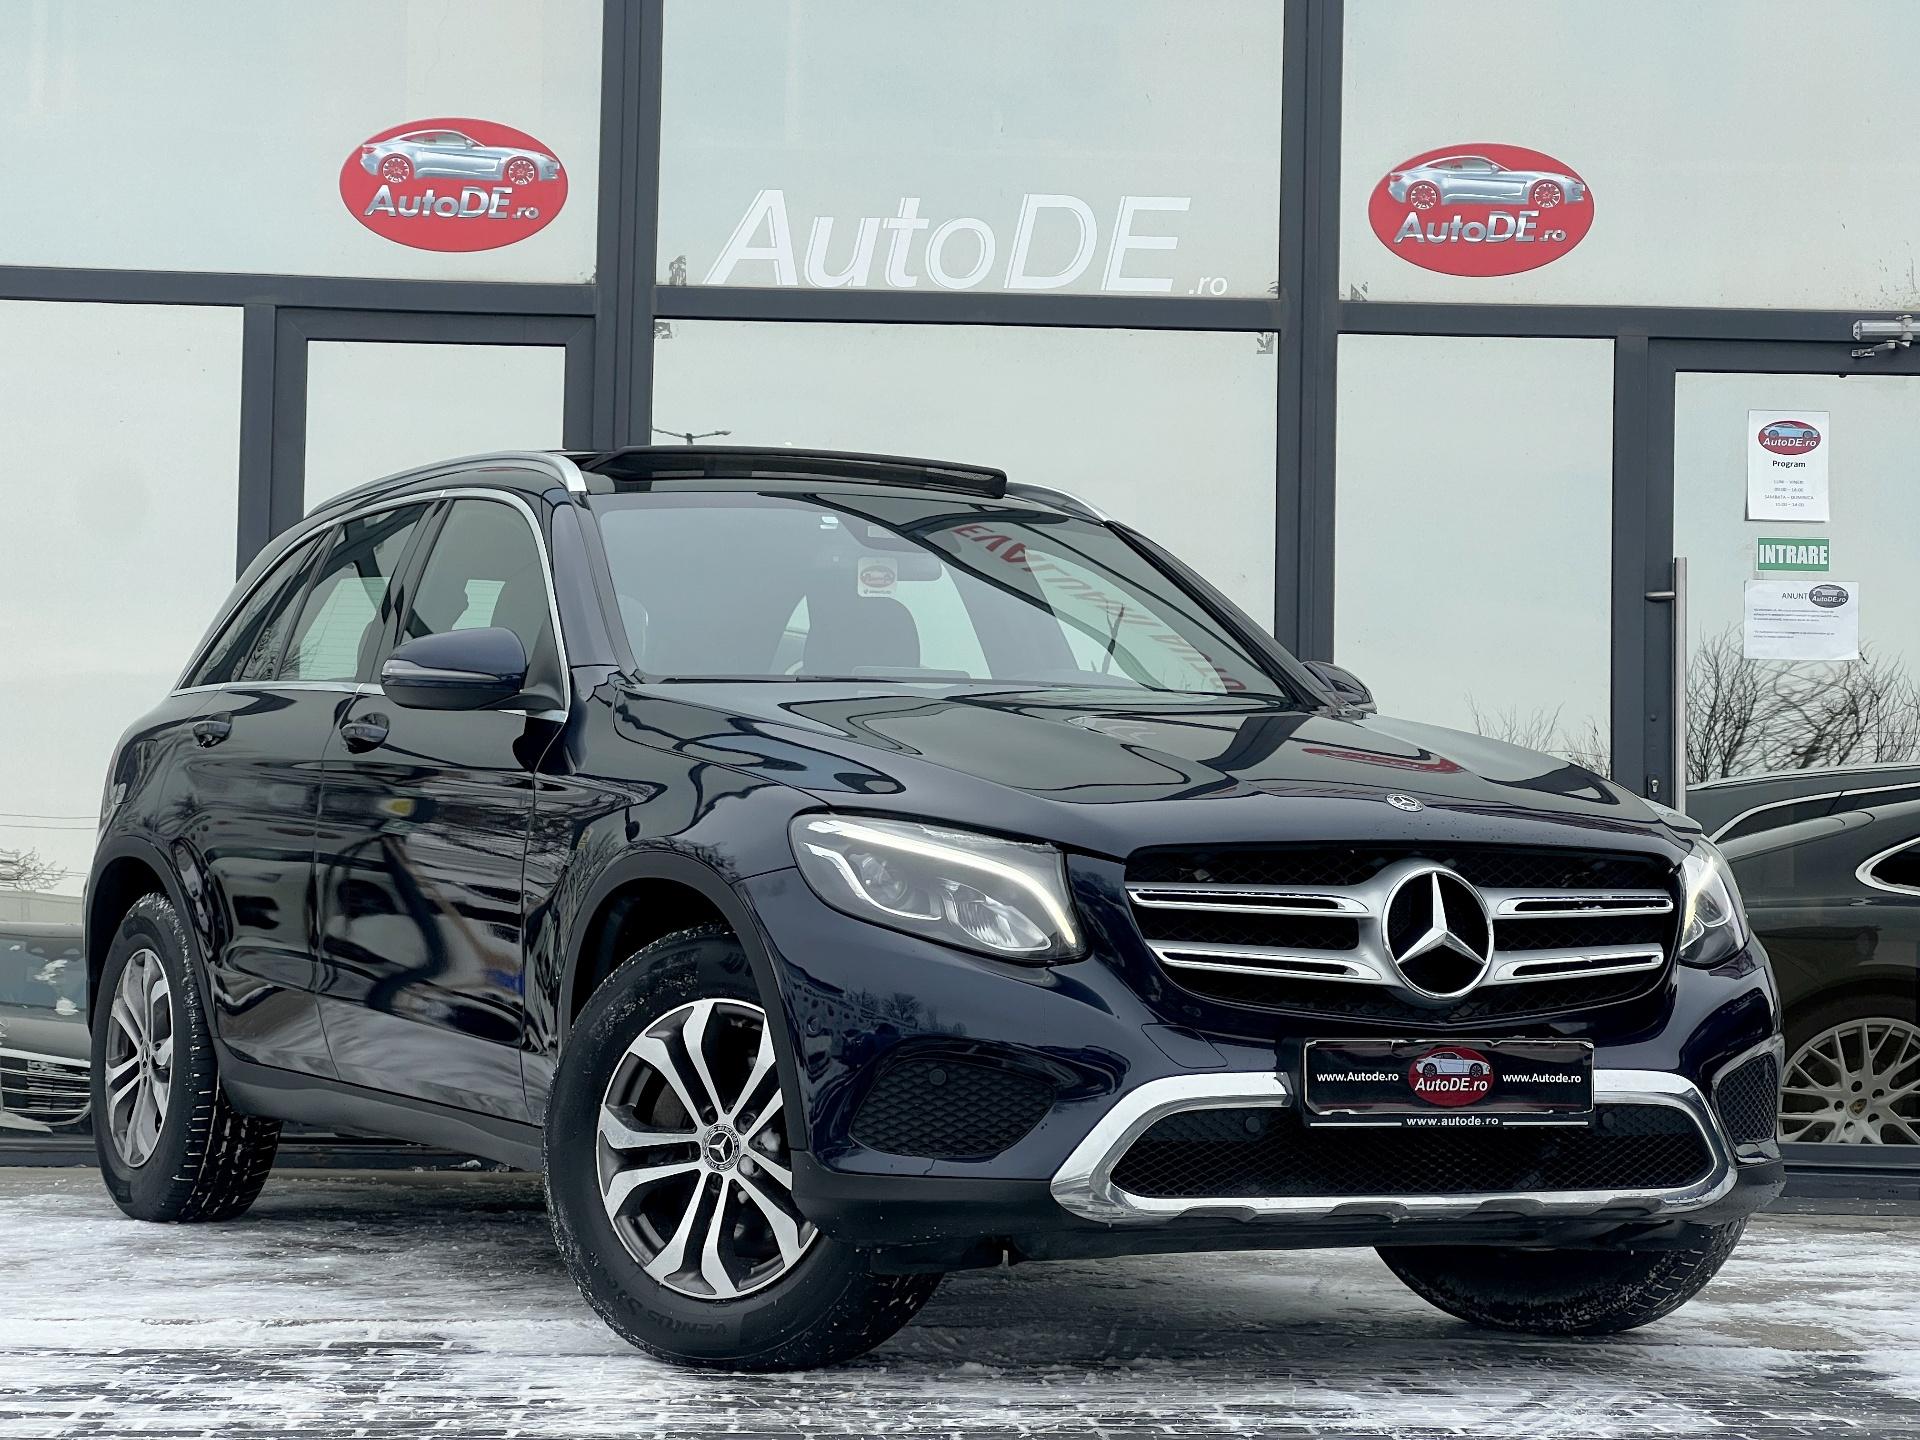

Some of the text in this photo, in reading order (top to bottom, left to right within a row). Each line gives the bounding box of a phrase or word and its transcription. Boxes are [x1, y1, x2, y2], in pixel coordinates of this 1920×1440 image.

[1763, 438, 1817, 447] AutoDE.ro
[1772, 460, 1806, 469] Program
[1759, 544, 1828, 565] INTRARE
[1316, 1071, 1399, 1082] www.Autode.ro
[1502, 1072, 1582, 1084] www.Autode.ro
[1414, 1077, 1488, 1092] AutoDE.ro
[1406, 1115, 1499, 1126] www.autode.ro
